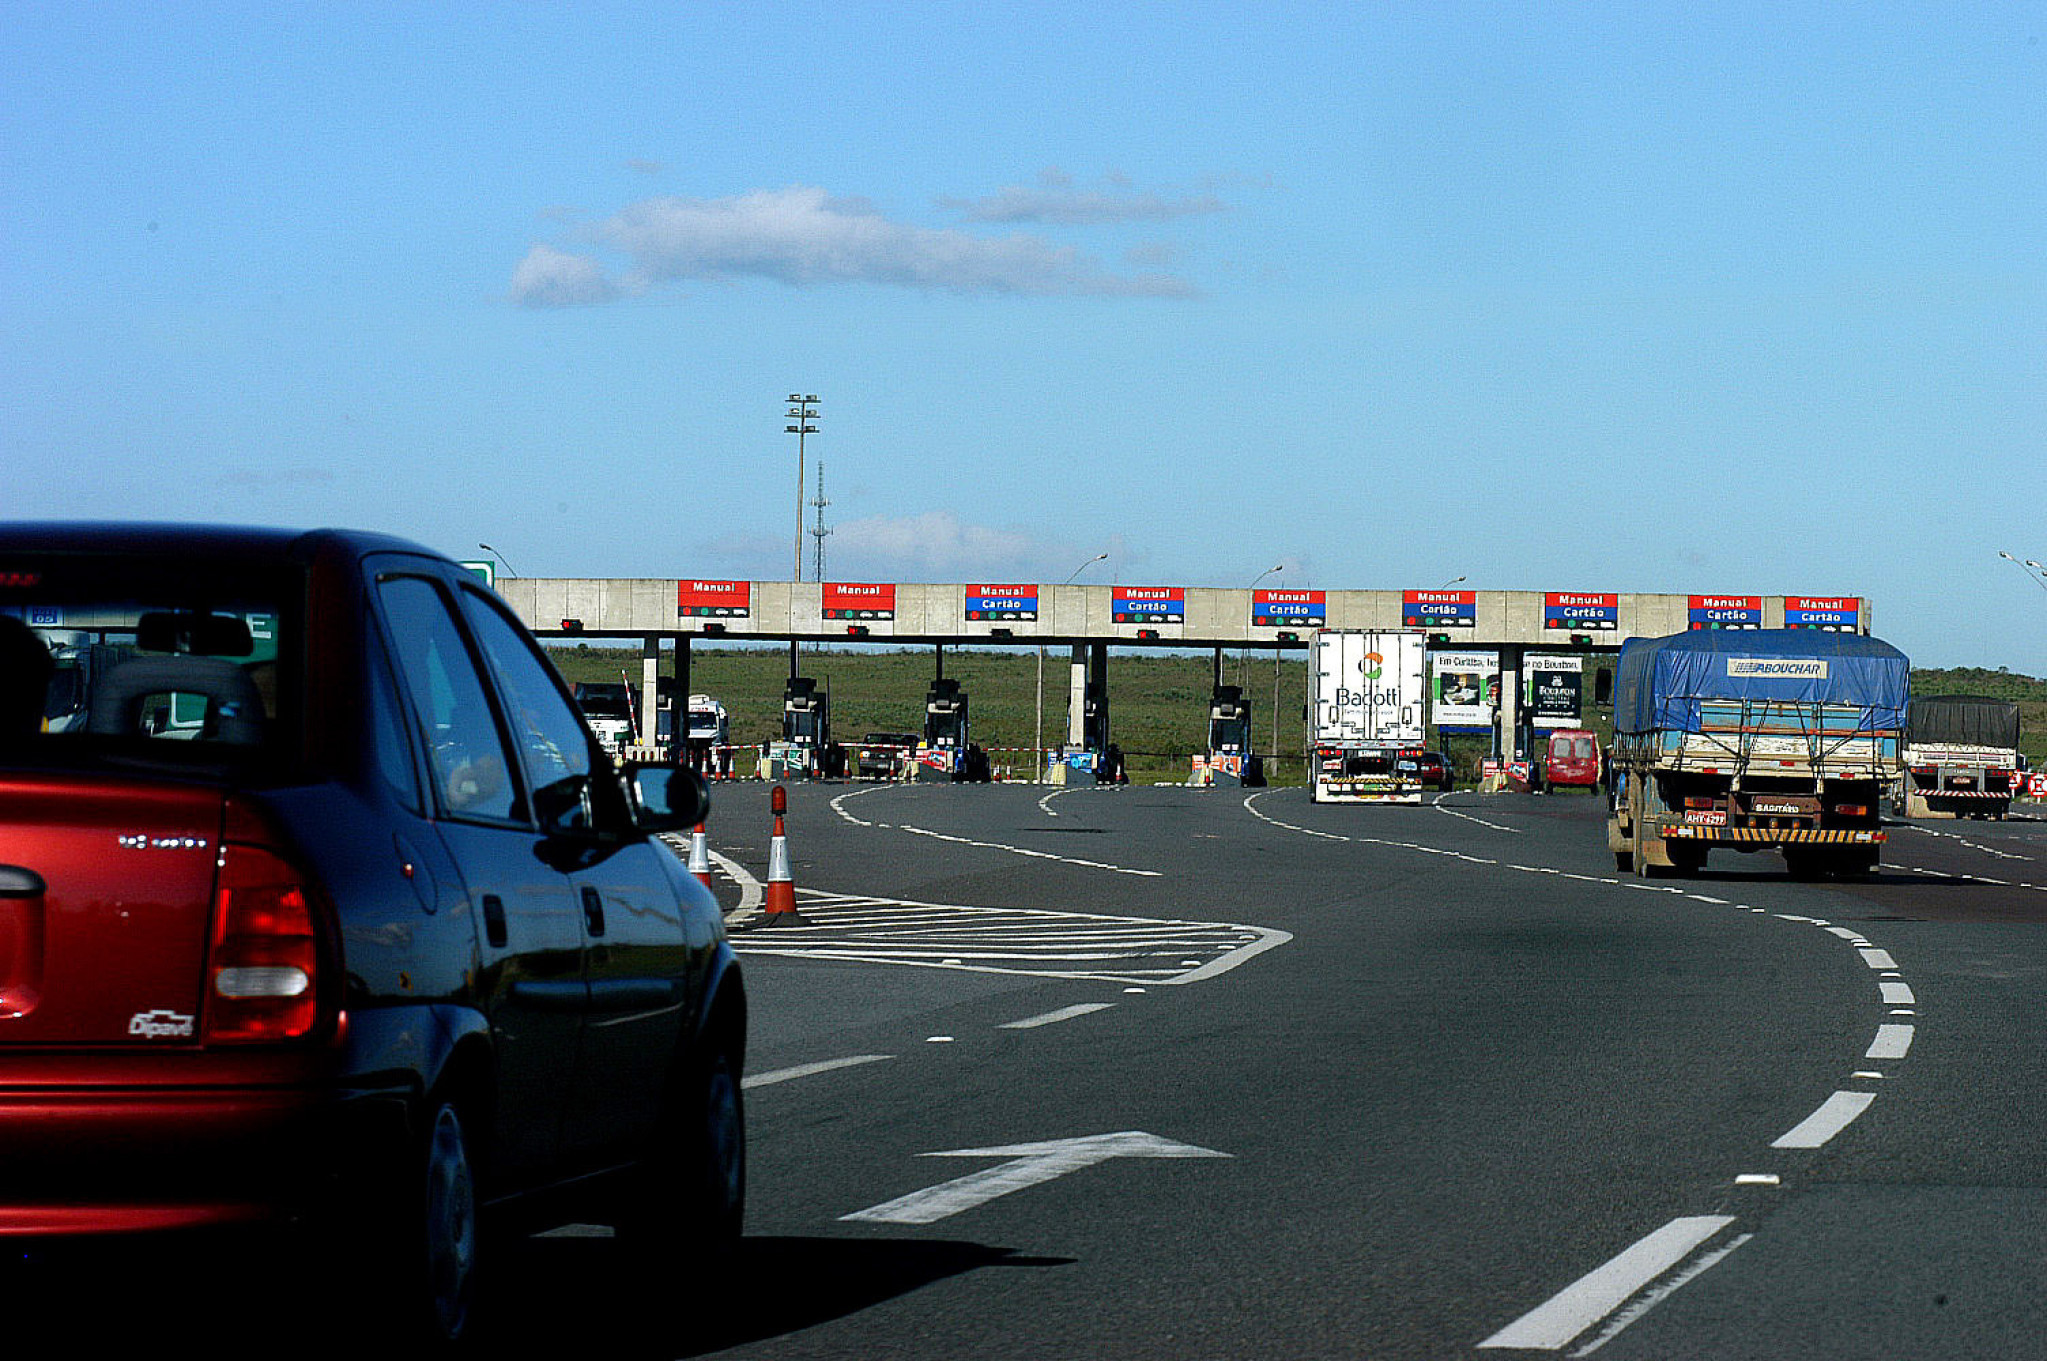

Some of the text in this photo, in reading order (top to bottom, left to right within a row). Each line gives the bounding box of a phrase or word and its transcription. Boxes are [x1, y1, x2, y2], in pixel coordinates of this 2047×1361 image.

[693, 582, 735, 592] Manual
[837, 585, 880, 595] Manual
[980, 586, 1024, 596] Manual
[1126, 589, 1170, 599] Manual
[1268, 592, 1310, 602] Manual
[1417, 592, 1460, 603] Manual
[982, 599, 1022, 609] Cartão
[1559, 595, 1603, 605] Manual
[1703, 598, 1747, 608] Manual
[1799, 599, 1843, 609] Manual
[1128, 602, 1167, 612] Cartão
[1269, 605, 1309, 615] Cartão
[1420, 605, 1457, 615] Cartão
[1564, 607, 1604, 618] Cartão
[1707, 609, 1748, 620] Cartão
[1801, 612, 1841, 622] Cartão
[1439, 656, 1452, 666] Em
[1755, 663, 1820, 675] ABOUCHAR
[1336, 688, 1401, 707] Badotti
